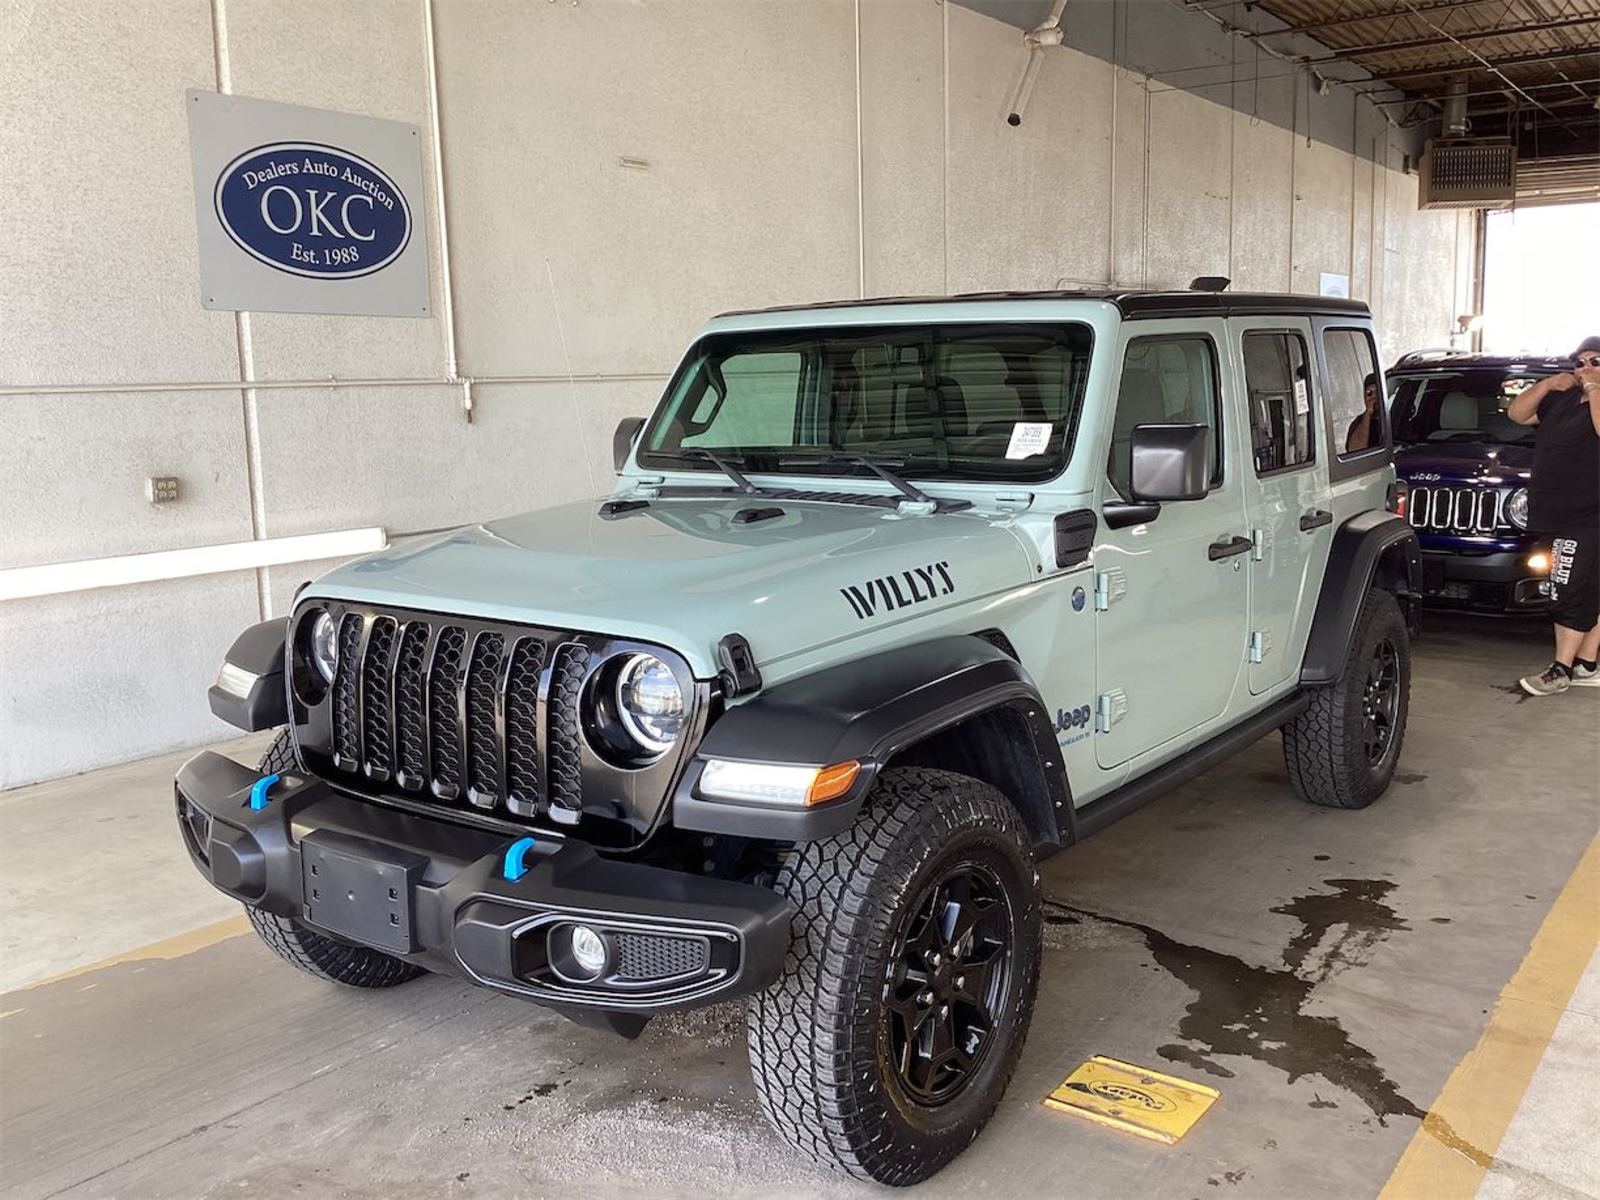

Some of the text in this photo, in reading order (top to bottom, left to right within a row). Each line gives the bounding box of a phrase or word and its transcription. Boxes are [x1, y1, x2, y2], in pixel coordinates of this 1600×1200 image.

[242, 158, 394, 211] Dealers Auto Auction
[260, 185, 376, 241] OKC
[290, 243, 360, 266] Est. 1988
[1563, 539, 1578, 555] GO
[1556, 556, 1574, 585] BLUE
[840, 561, 954, 619] WILLYS
[1052, 704, 1090, 734] Jeep
